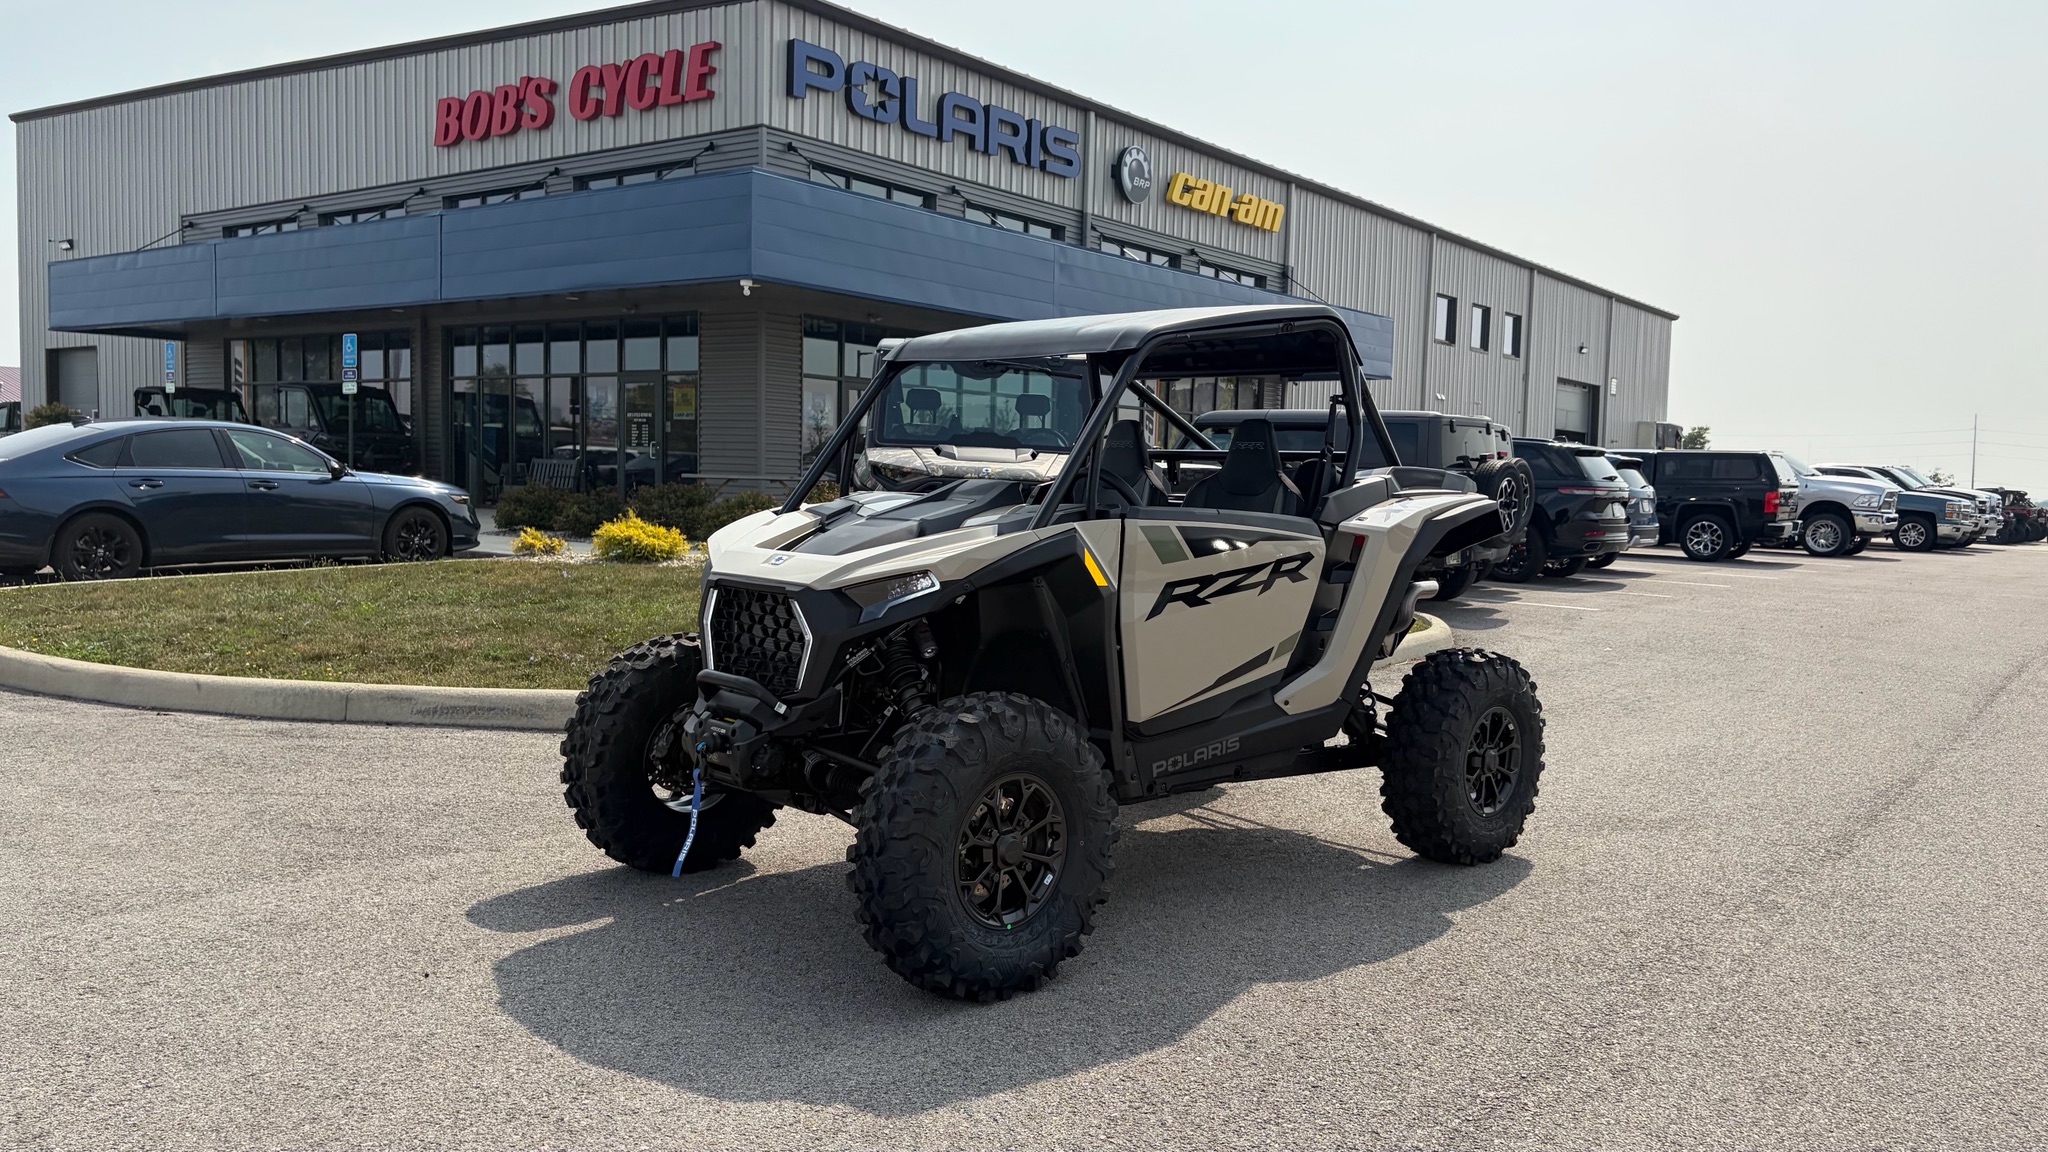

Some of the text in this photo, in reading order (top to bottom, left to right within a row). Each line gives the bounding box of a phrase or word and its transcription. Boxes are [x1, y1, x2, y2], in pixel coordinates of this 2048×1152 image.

[434, 41, 722, 147] BOB'S CYCLE
[787, 38, 1081, 178] POLARIS
[1133, 176, 1151, 189] BRP
[1166, 172, 1284, 233] can-am
[1144, 551, 1315, 622] RZR
[1152, 736, 1240, 778] POLARIS
[678, 808, 698, 861] POLARIS
